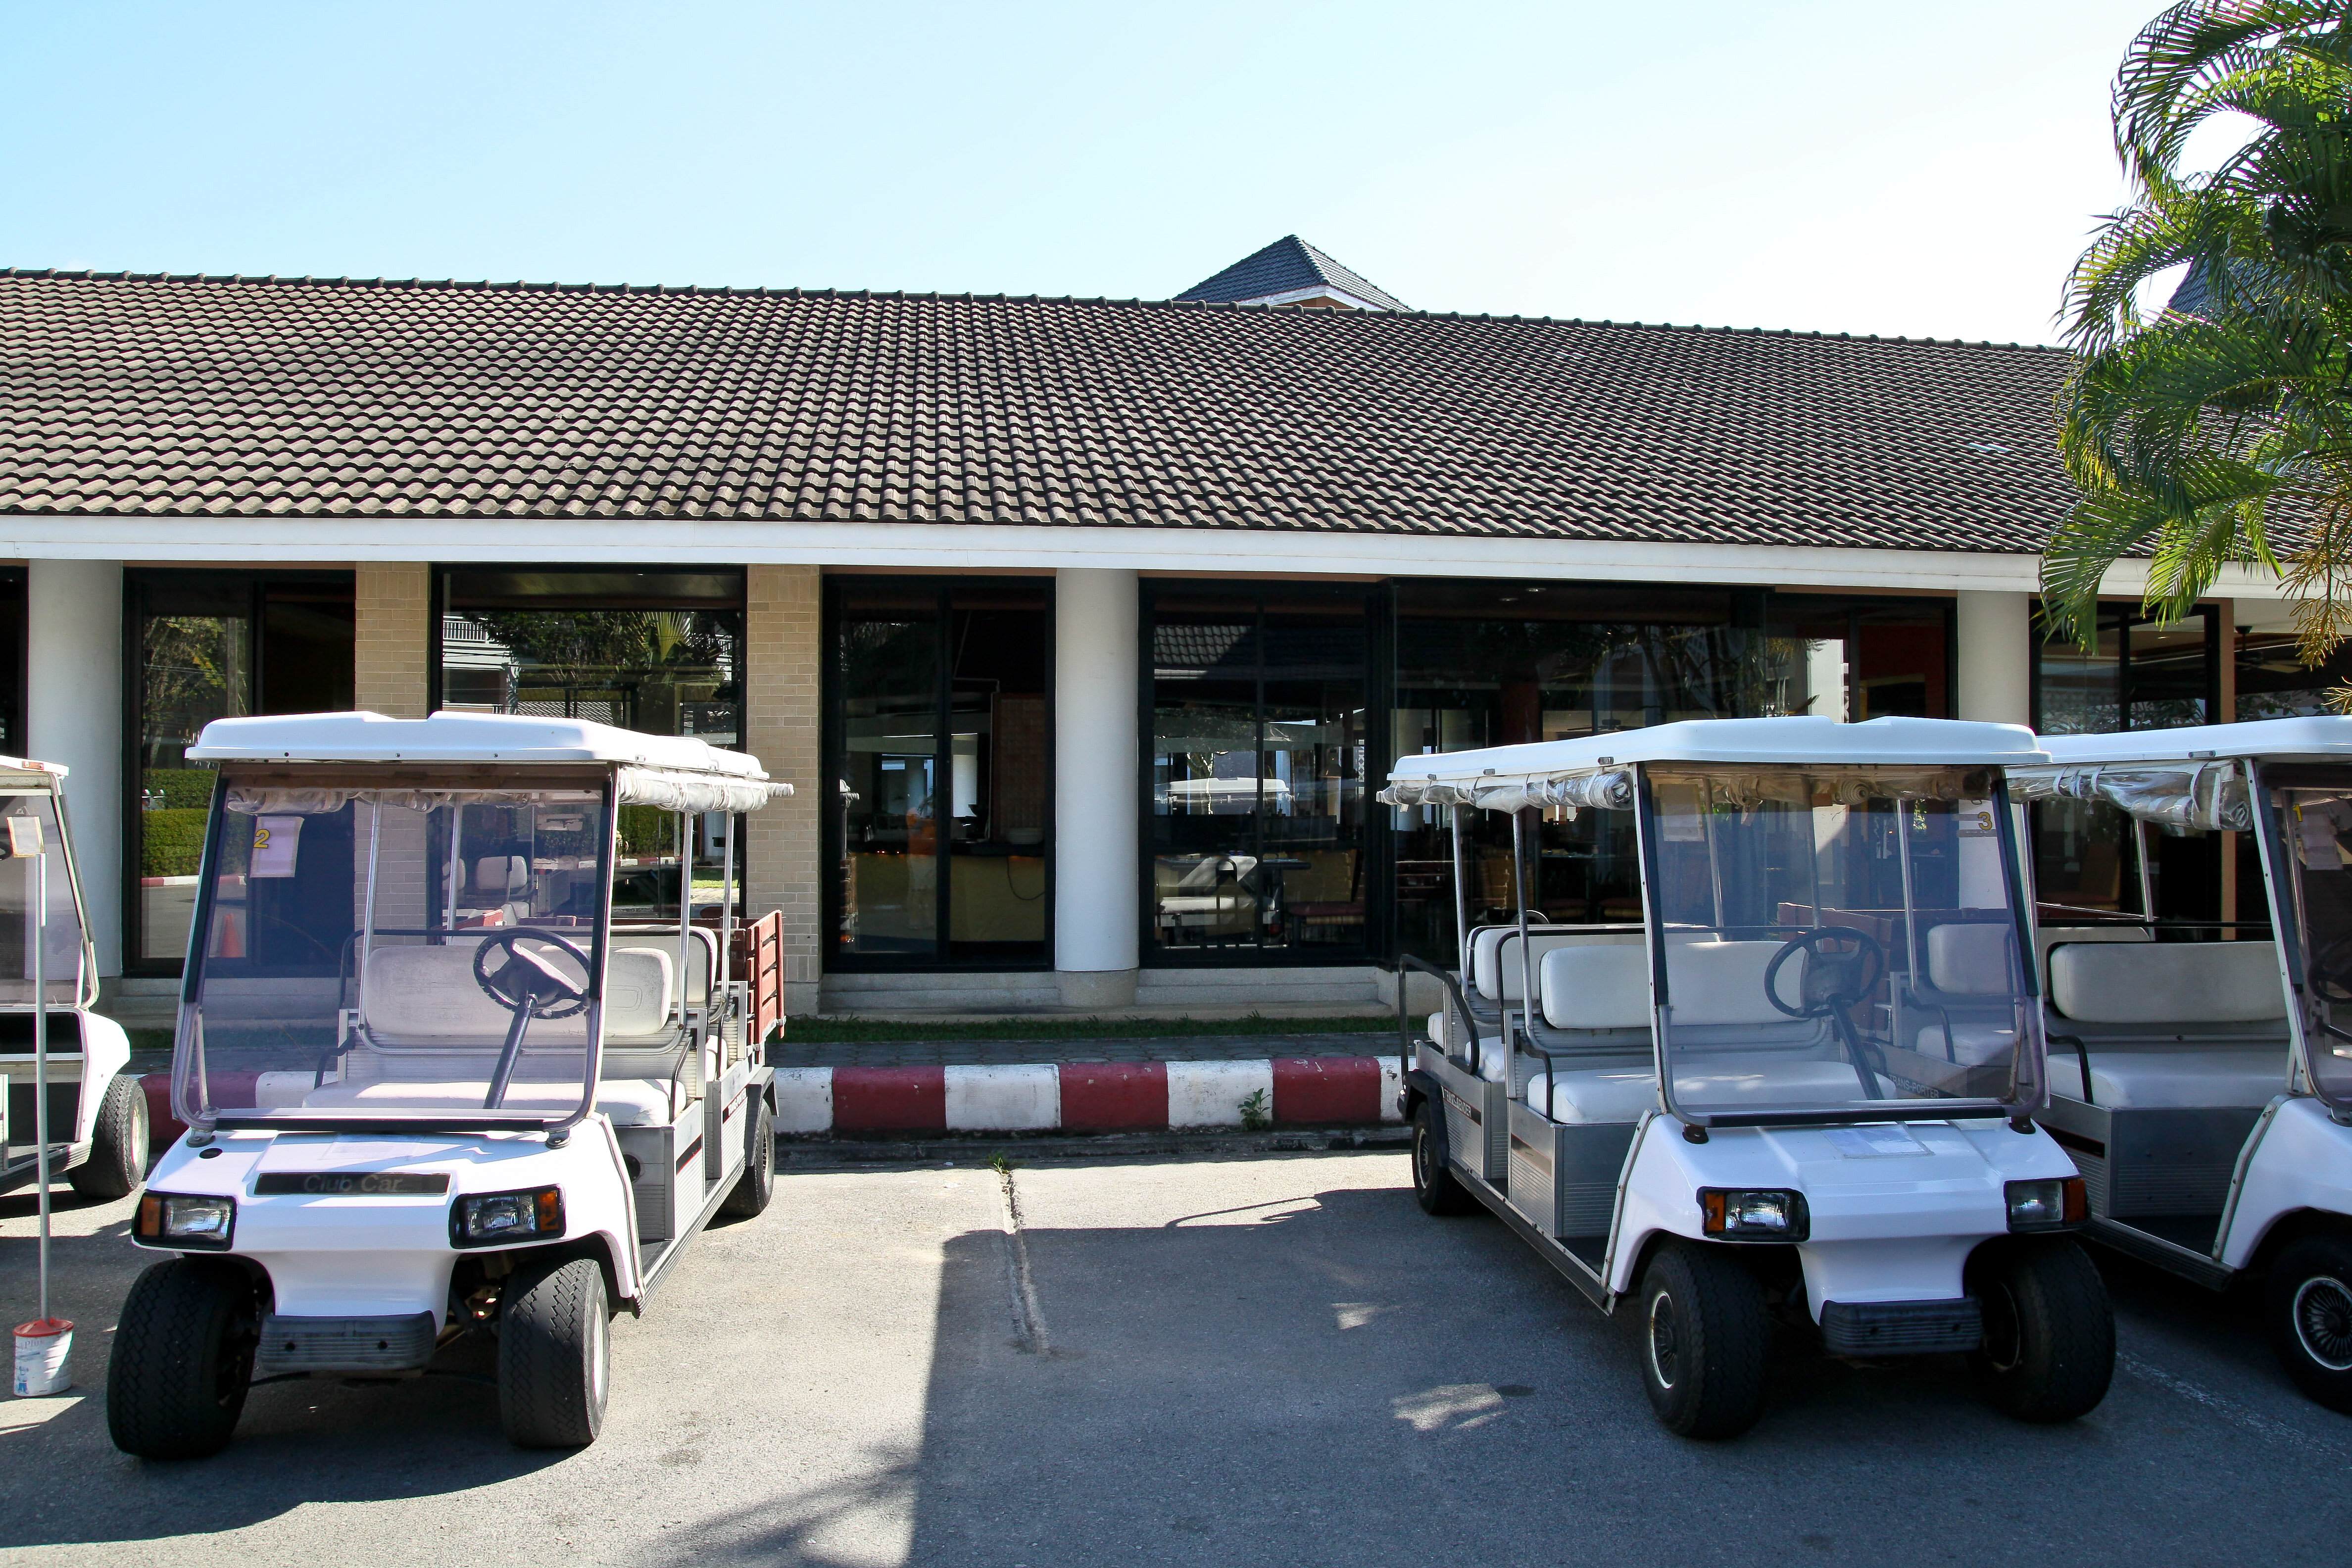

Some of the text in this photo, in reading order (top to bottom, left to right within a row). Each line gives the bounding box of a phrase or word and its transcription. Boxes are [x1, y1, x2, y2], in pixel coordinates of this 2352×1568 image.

[1978, 811, 1993, 831] 3
[2293, 804, 2303, 822] 1
[253, 829, 270, 848] 2
[1889, 1074, 1939, 1098] TRANS-PORTER
[304, 1174, 403, 1192] Club Car
